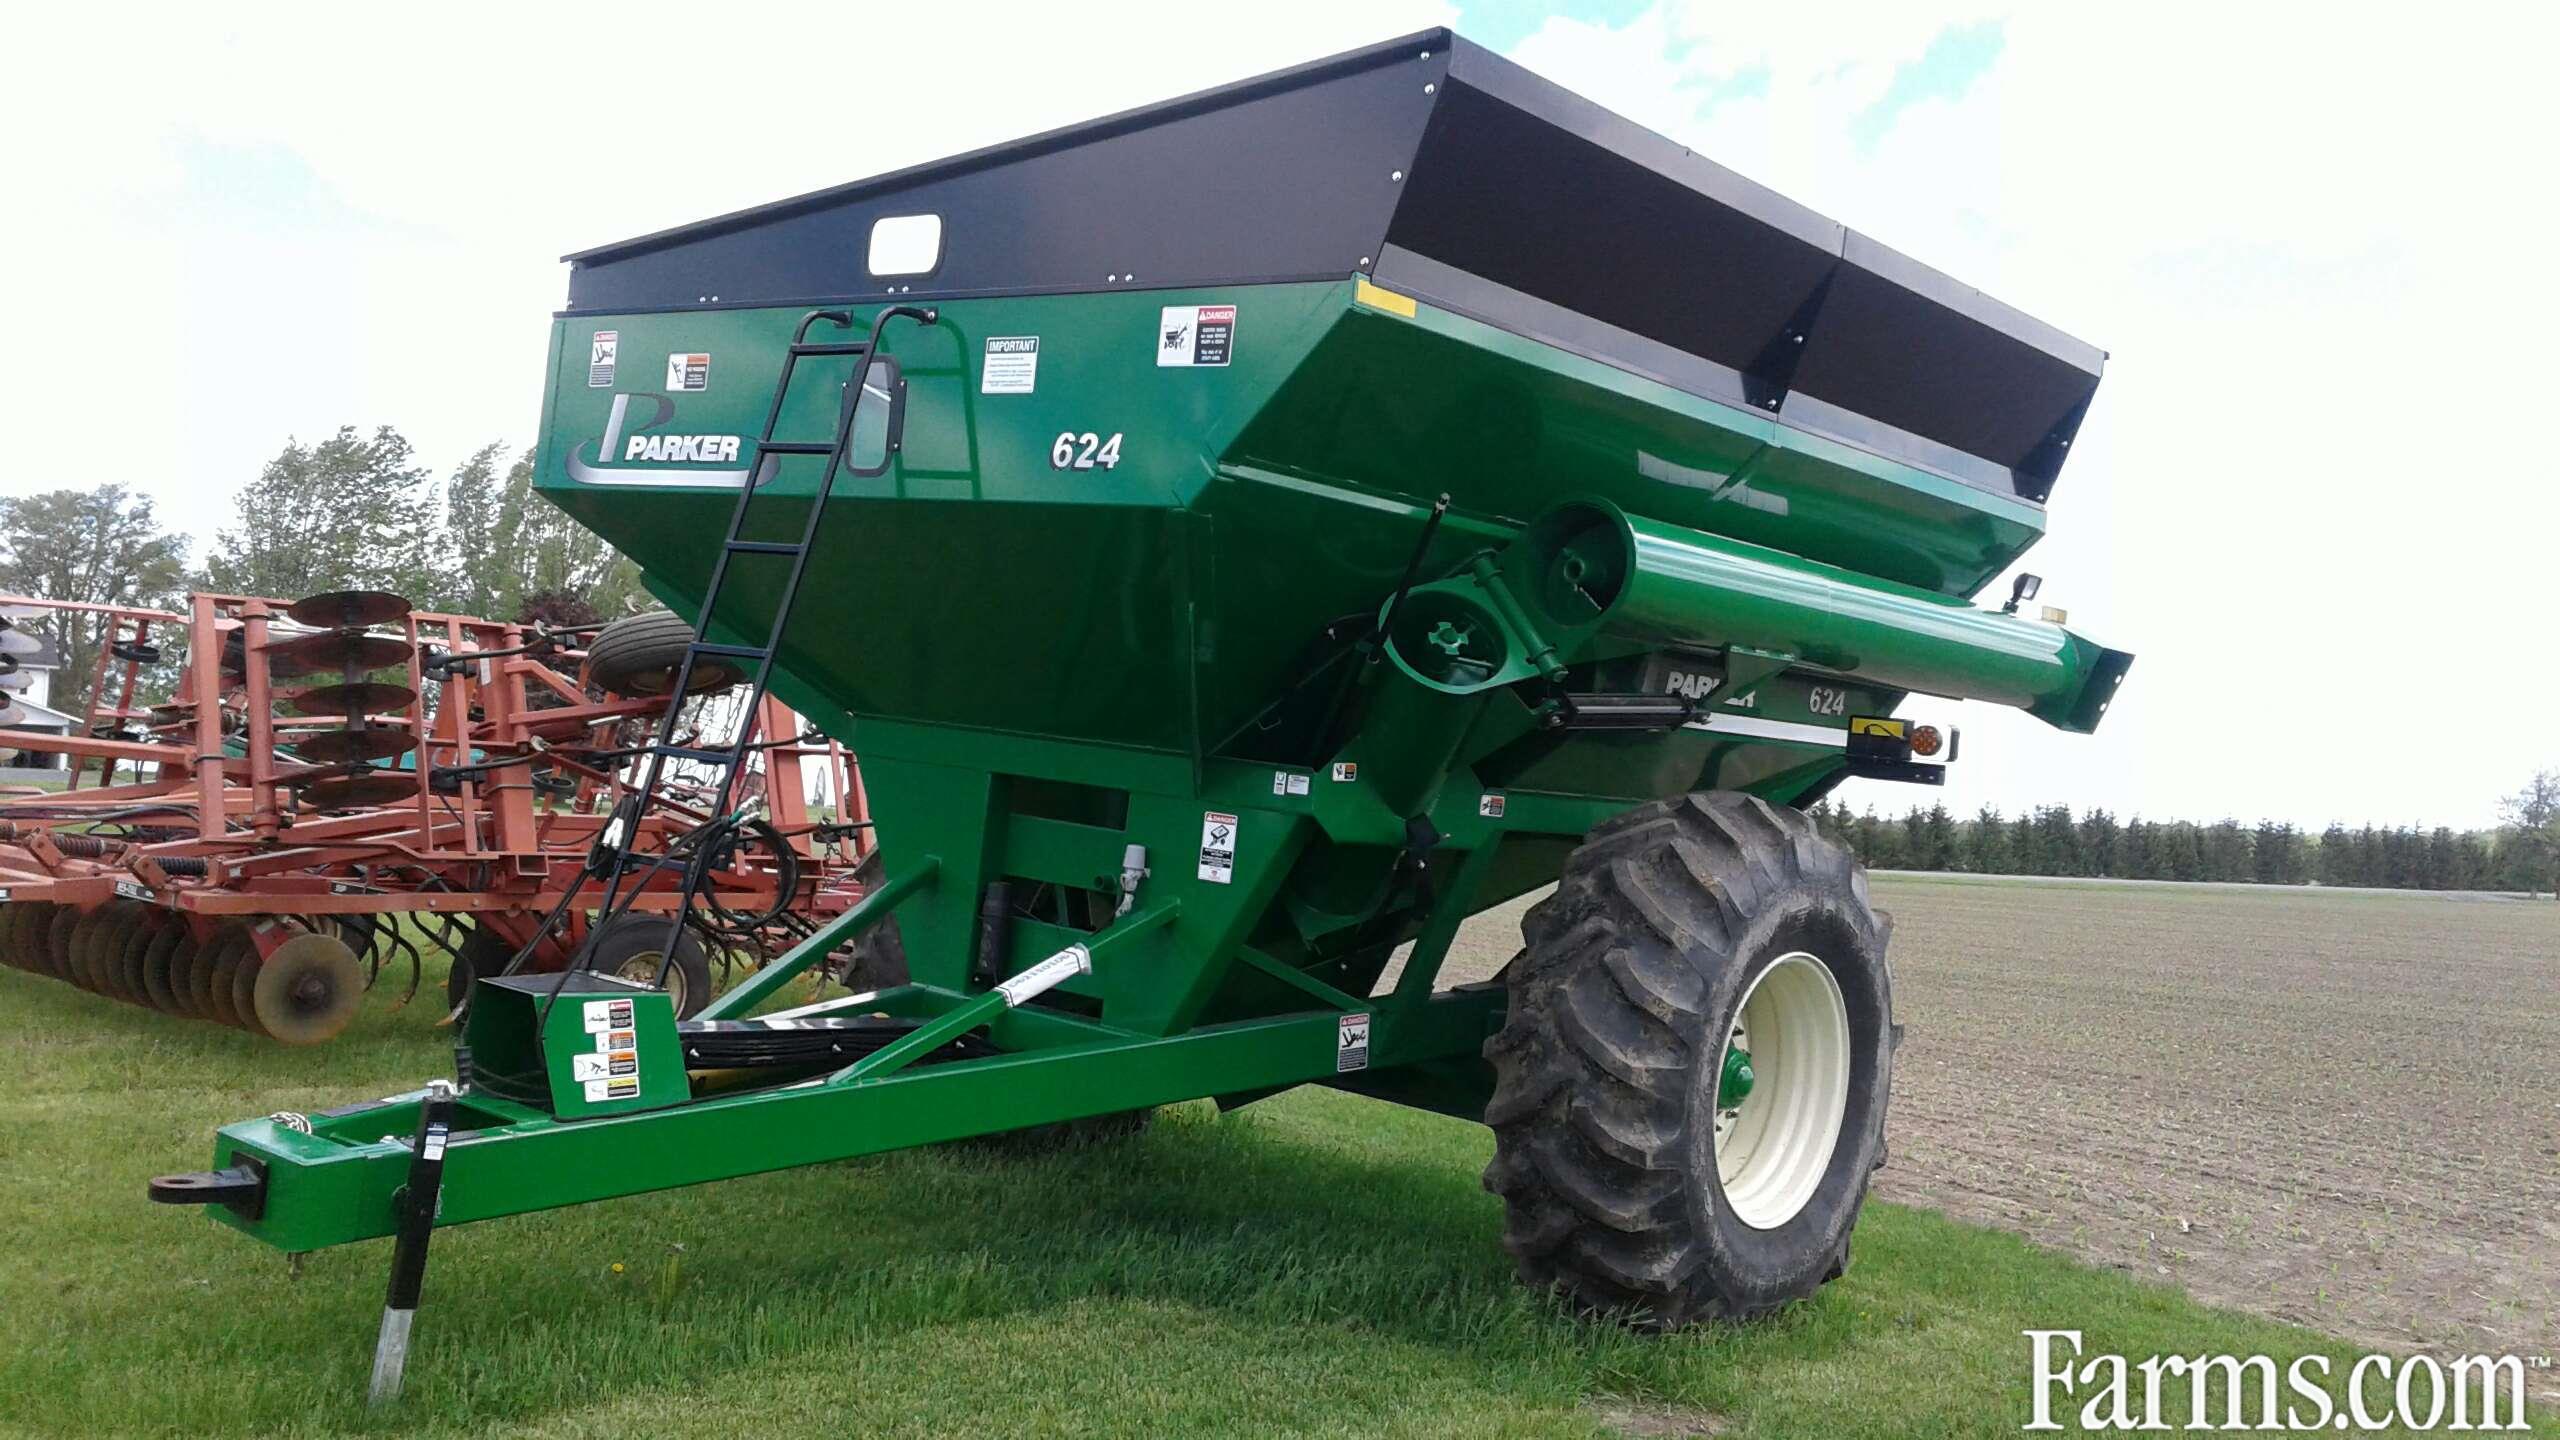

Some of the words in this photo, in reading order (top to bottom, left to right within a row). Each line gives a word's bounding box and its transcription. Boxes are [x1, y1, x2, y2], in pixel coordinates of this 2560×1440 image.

[1206, 311, 1233, 320] DANGER
[989, 340, 1036, 352] IMPORTANT
[625, 435, 741, 462] PARKER
[1051, 431, 1124, 471] 624
[1809, 687, 1846, 716] 624
